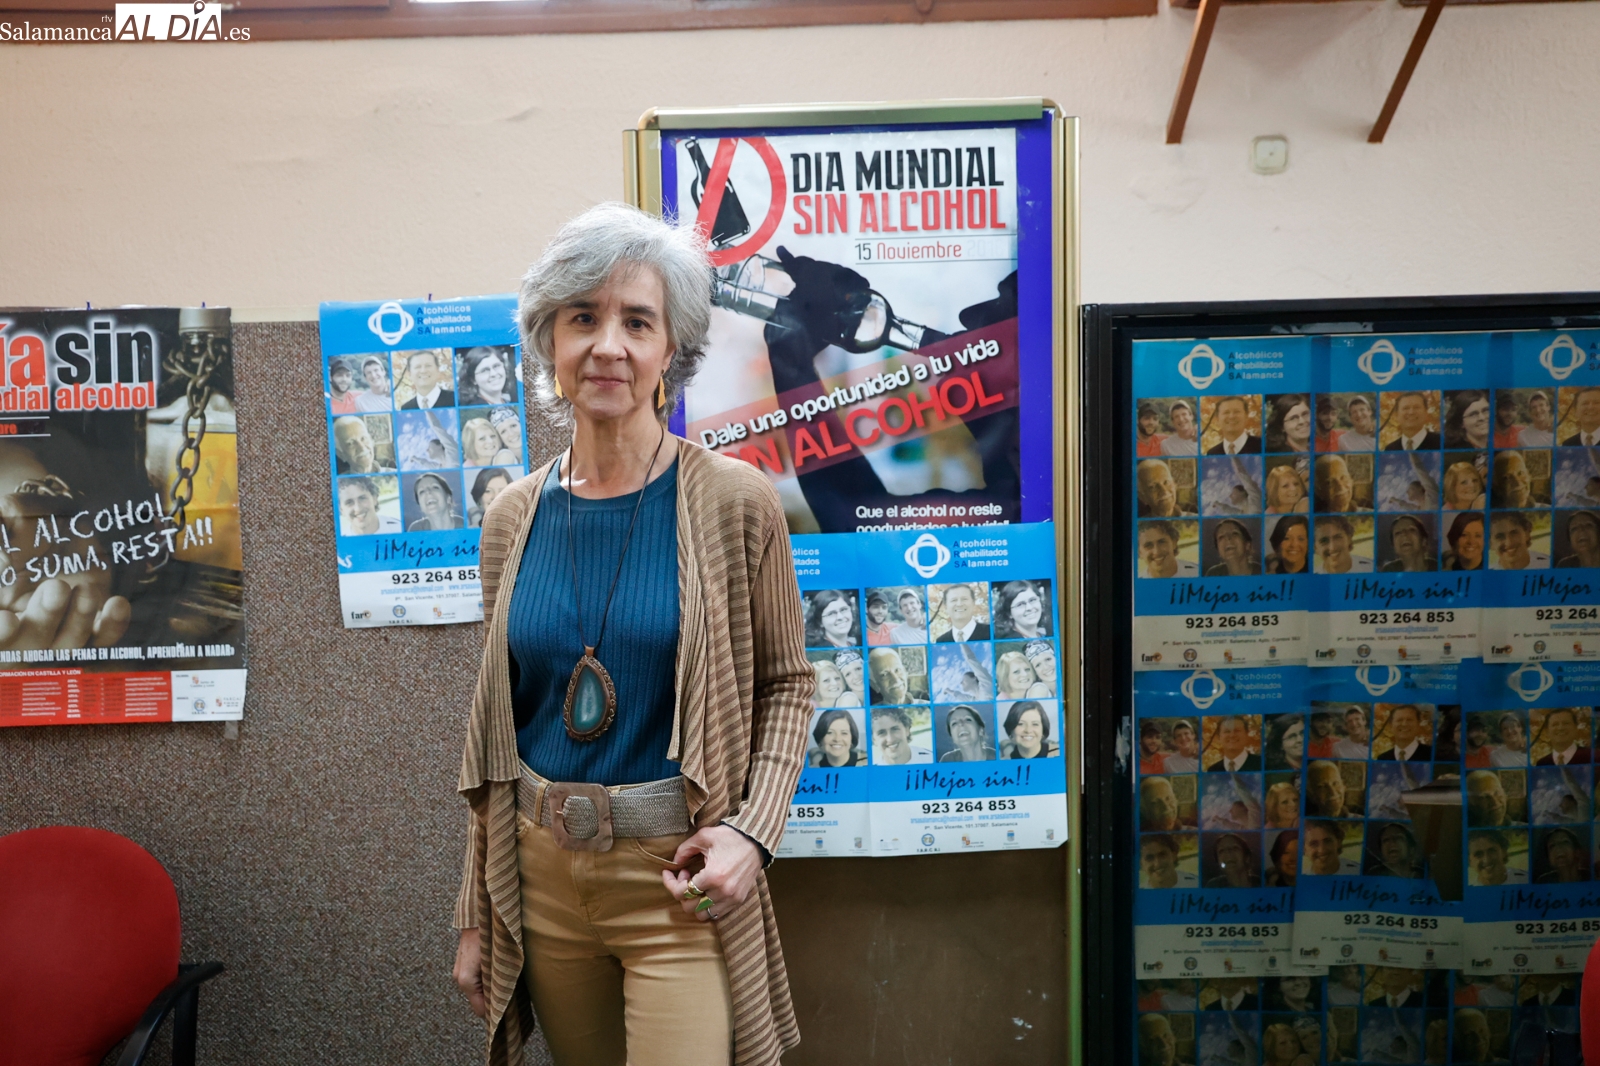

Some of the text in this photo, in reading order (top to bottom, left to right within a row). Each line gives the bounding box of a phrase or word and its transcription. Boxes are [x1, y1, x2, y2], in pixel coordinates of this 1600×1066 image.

[790, 147, 1004, 193] DIA MUNDIAL
[793, 188, 1006, 235] SIN ALCOHOL
[854, 242, 872, 260] 15
[877, 242, 962, 260] Noviembre
[416, 305, 471, 315] Alcohólicos
[417, 314, 472, 325] Rehabilitados
[54, 322, 153, 386] sin
[55, 380, 157, 410] alcohol
[700, 339, 1000, 450] Dale una oportunidad a tu vida
[795, 371, 1004, 468] ALCOHOL
[856, 503, 1002, 518] Que el alcohol no reste
[34, 492, 174, 548] ALCOHOL
[26, 545, 108, 583] SUMA,
[112, 516, 213, 565] RESTA!!
[953, 538, 1008, 548] Alcohólicos
[953, 548, 1008, 558] Rehabilitados
[392, 572, 420, 584] 923
[425, 570, 453, 582] 264
[1186, 615, 1279, 628] 923 264 853
[1360, 612, 1454, 624] 923 264 853
[1536, 608, 1597, 620] 923 264
[23, 649, 54, 662] AHOGAR
[56, 649, 70, 661] LAS
[72, 648, 97, 661] PENAS
[98, 648, 108, 660] EN
[110, 646, 145, 660] ALCOHOL,
[197, 645, 204, 657] A
[797, 807, 824, 818] 853
[922, 799, 1016, 814] 923 264 853
[1344, 914, 1438, 929] 923 264 853
[1516, 923, 1544, 934] 923
[1550, 922, 1577, 933] 264
[1186, 926, 1279, 937] 923 264 853
